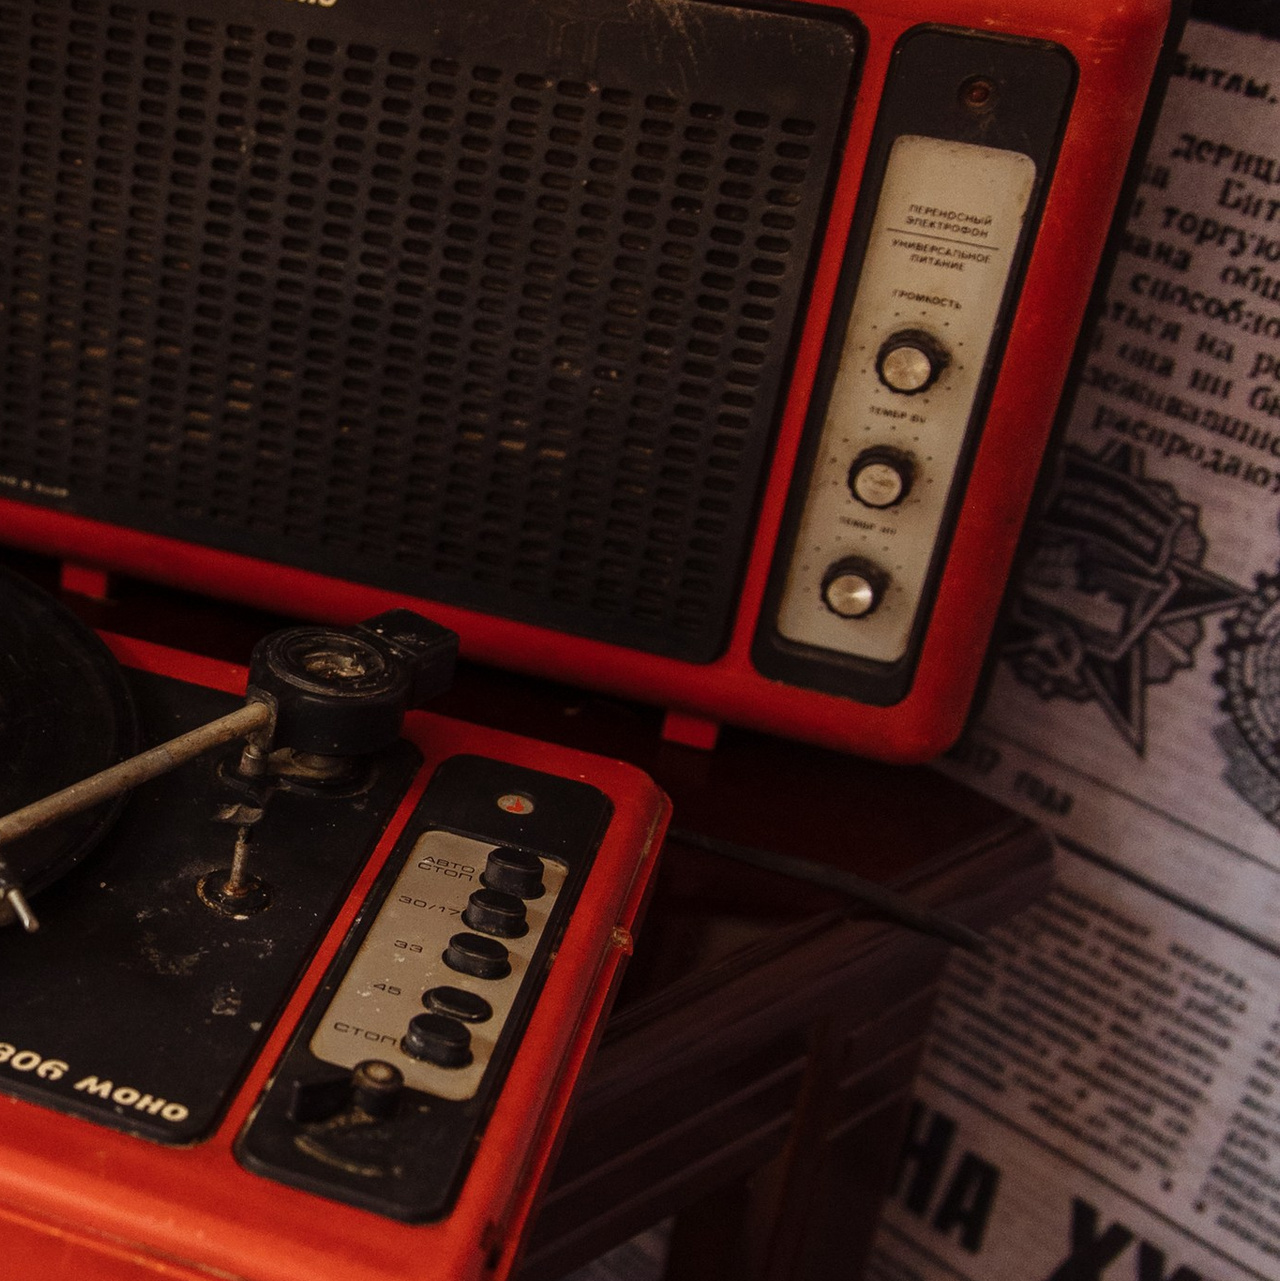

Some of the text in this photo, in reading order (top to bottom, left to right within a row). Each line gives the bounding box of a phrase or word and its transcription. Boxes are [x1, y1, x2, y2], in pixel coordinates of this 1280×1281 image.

[908, 203, 994, 226] ПЕРЕНОСНЫЙ
[905, 215, 989, 239] ЭЛЕКТРОФОН
[891, 238, 992, 265] УНИВЕРСАЛЬНОЕ
[909, 253, 965, 272] ПИТАНИЕ
[891, 288, 962, 310] ГРОМКОСТЬ
[417, 861, 474, 882] СТОП
[420, 855, 476, 874] АВТО
[398, 894, 462, 916] 30/17
[393, 939, 424, 954] 33
[372, 982, 403, 997] 45
[333, 1021, 398, 1046] СТОП
[73, 1074, 190, 1123] моно
